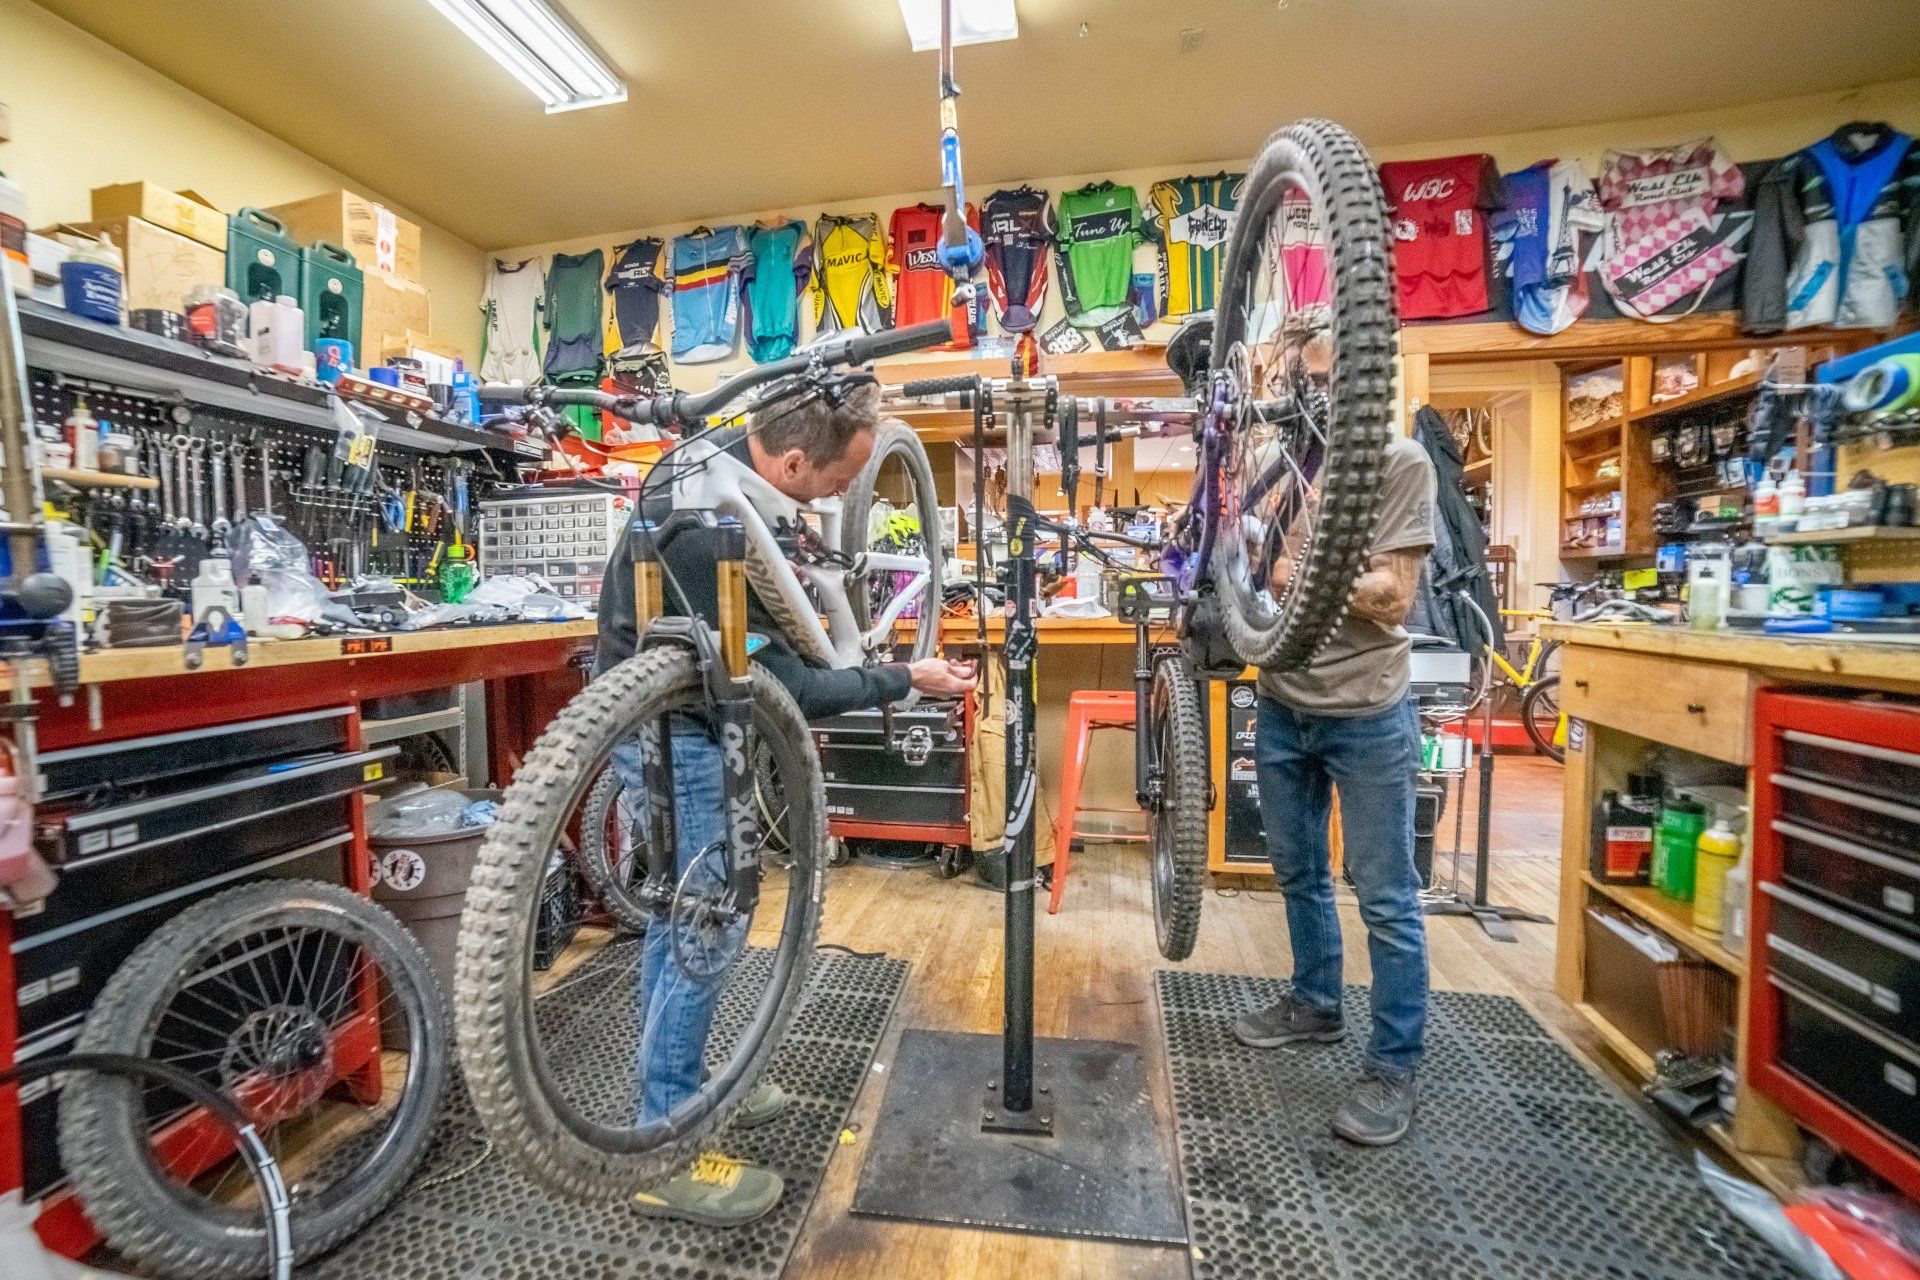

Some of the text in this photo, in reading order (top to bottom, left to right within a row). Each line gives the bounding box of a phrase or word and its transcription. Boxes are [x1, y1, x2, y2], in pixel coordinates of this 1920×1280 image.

[1109, 217, 1131, 237] Up
[826, 252, 863, 268] MAVIC
[876, 277, 888, 302] MAVIC
[730, 792, 761, 872] FOX
